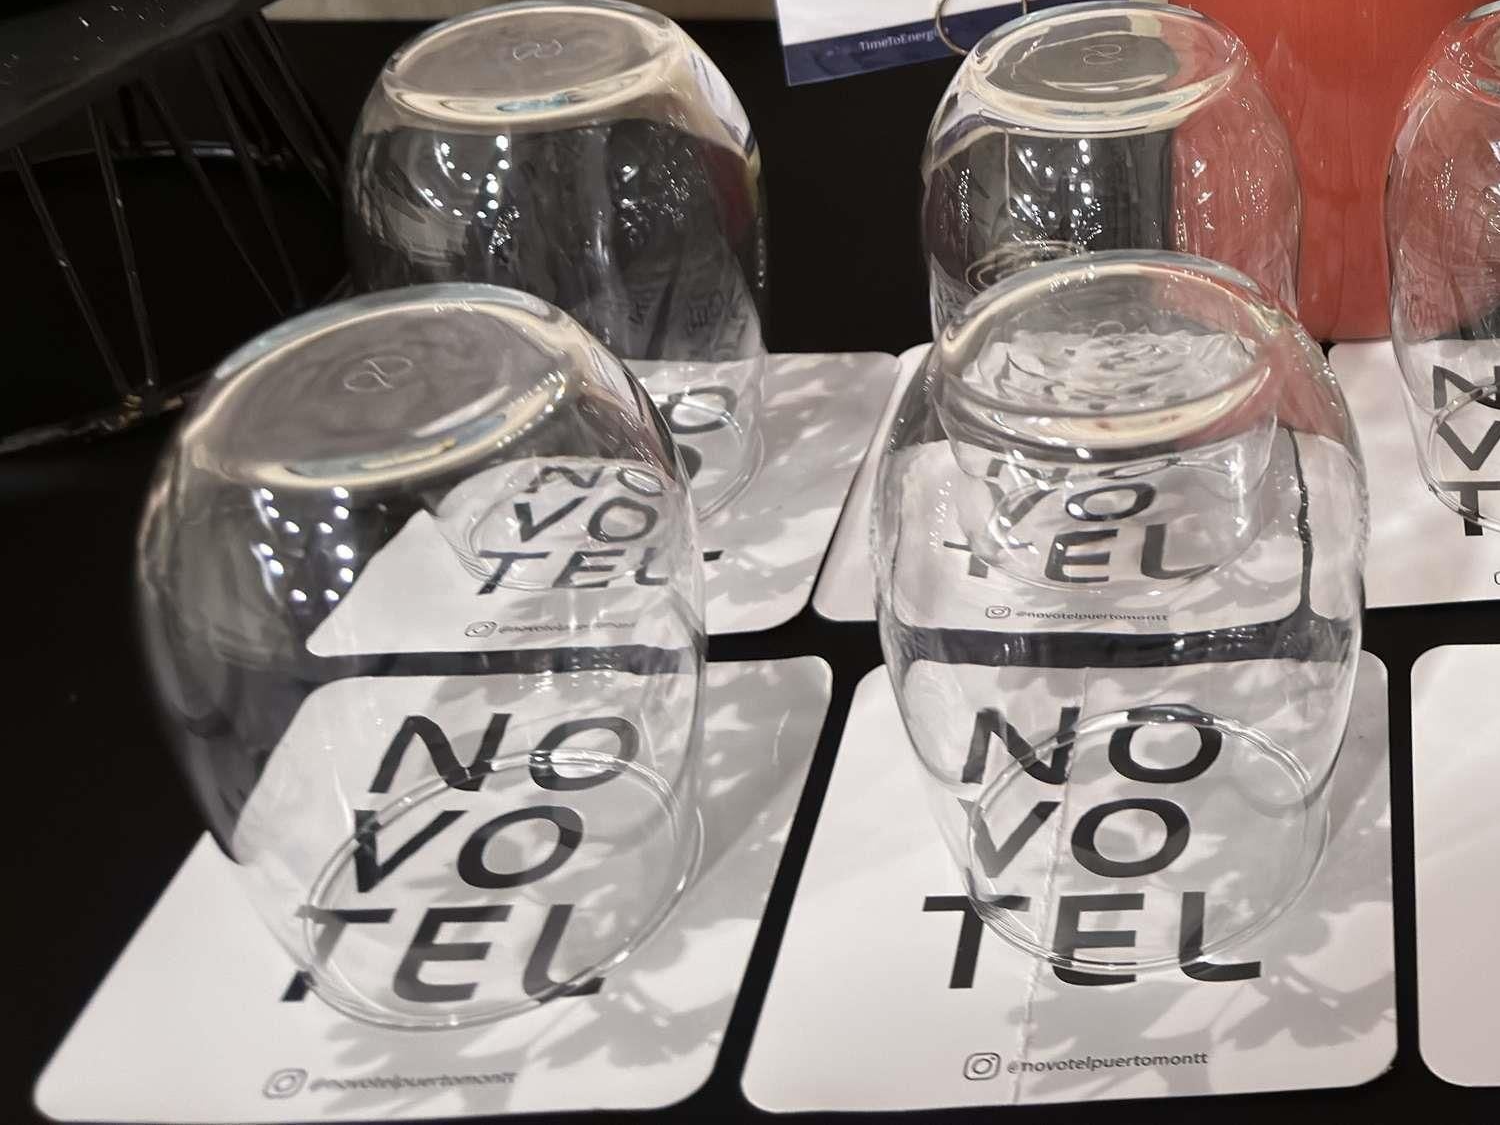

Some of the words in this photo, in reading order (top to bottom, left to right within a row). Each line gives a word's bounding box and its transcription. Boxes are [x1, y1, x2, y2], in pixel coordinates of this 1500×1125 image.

[513, 496, 658, 543] VO
[368, 713, 641, 791] NO
[961, 703, 1223, 784] NO
[353, 805, 584, 893] VO
[957, 797, 1191, 878] VO
[280, 904, 606, 1002] TEL
[922, 890, 1262, 988] TEL
[1007, 1052, 1209, 1073] @novotelpuertomontt
